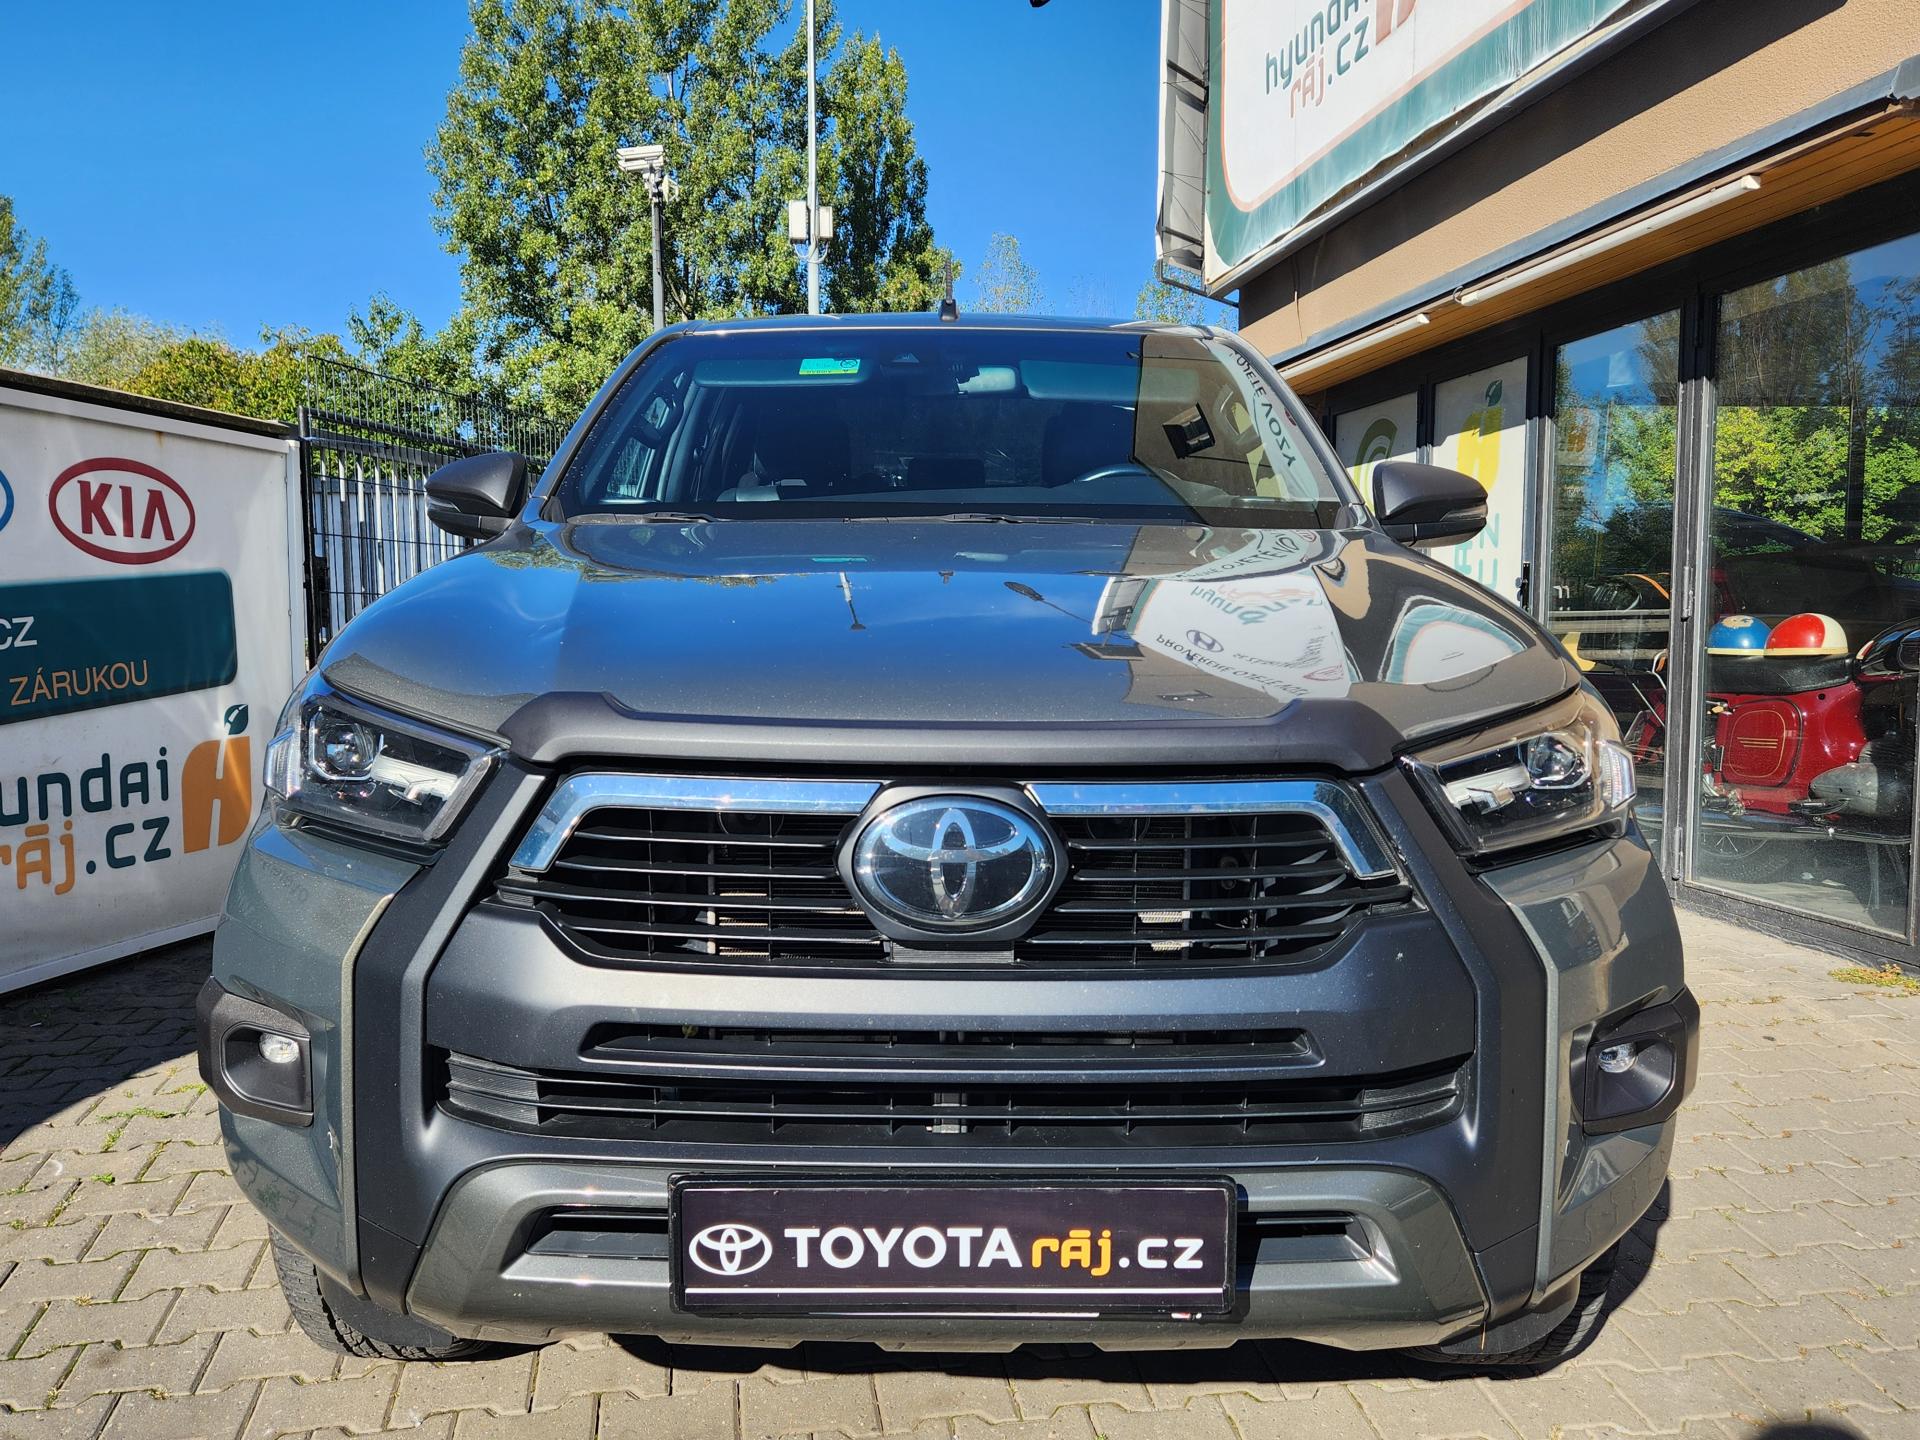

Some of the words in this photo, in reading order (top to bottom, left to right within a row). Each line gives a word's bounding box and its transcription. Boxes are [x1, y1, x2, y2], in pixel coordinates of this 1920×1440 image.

[77, 480, 175, 541] KIA
[9, 659, 148, 706] ZÁRUKOU
[784, 1226, 1022, 1269] TOYOTA
